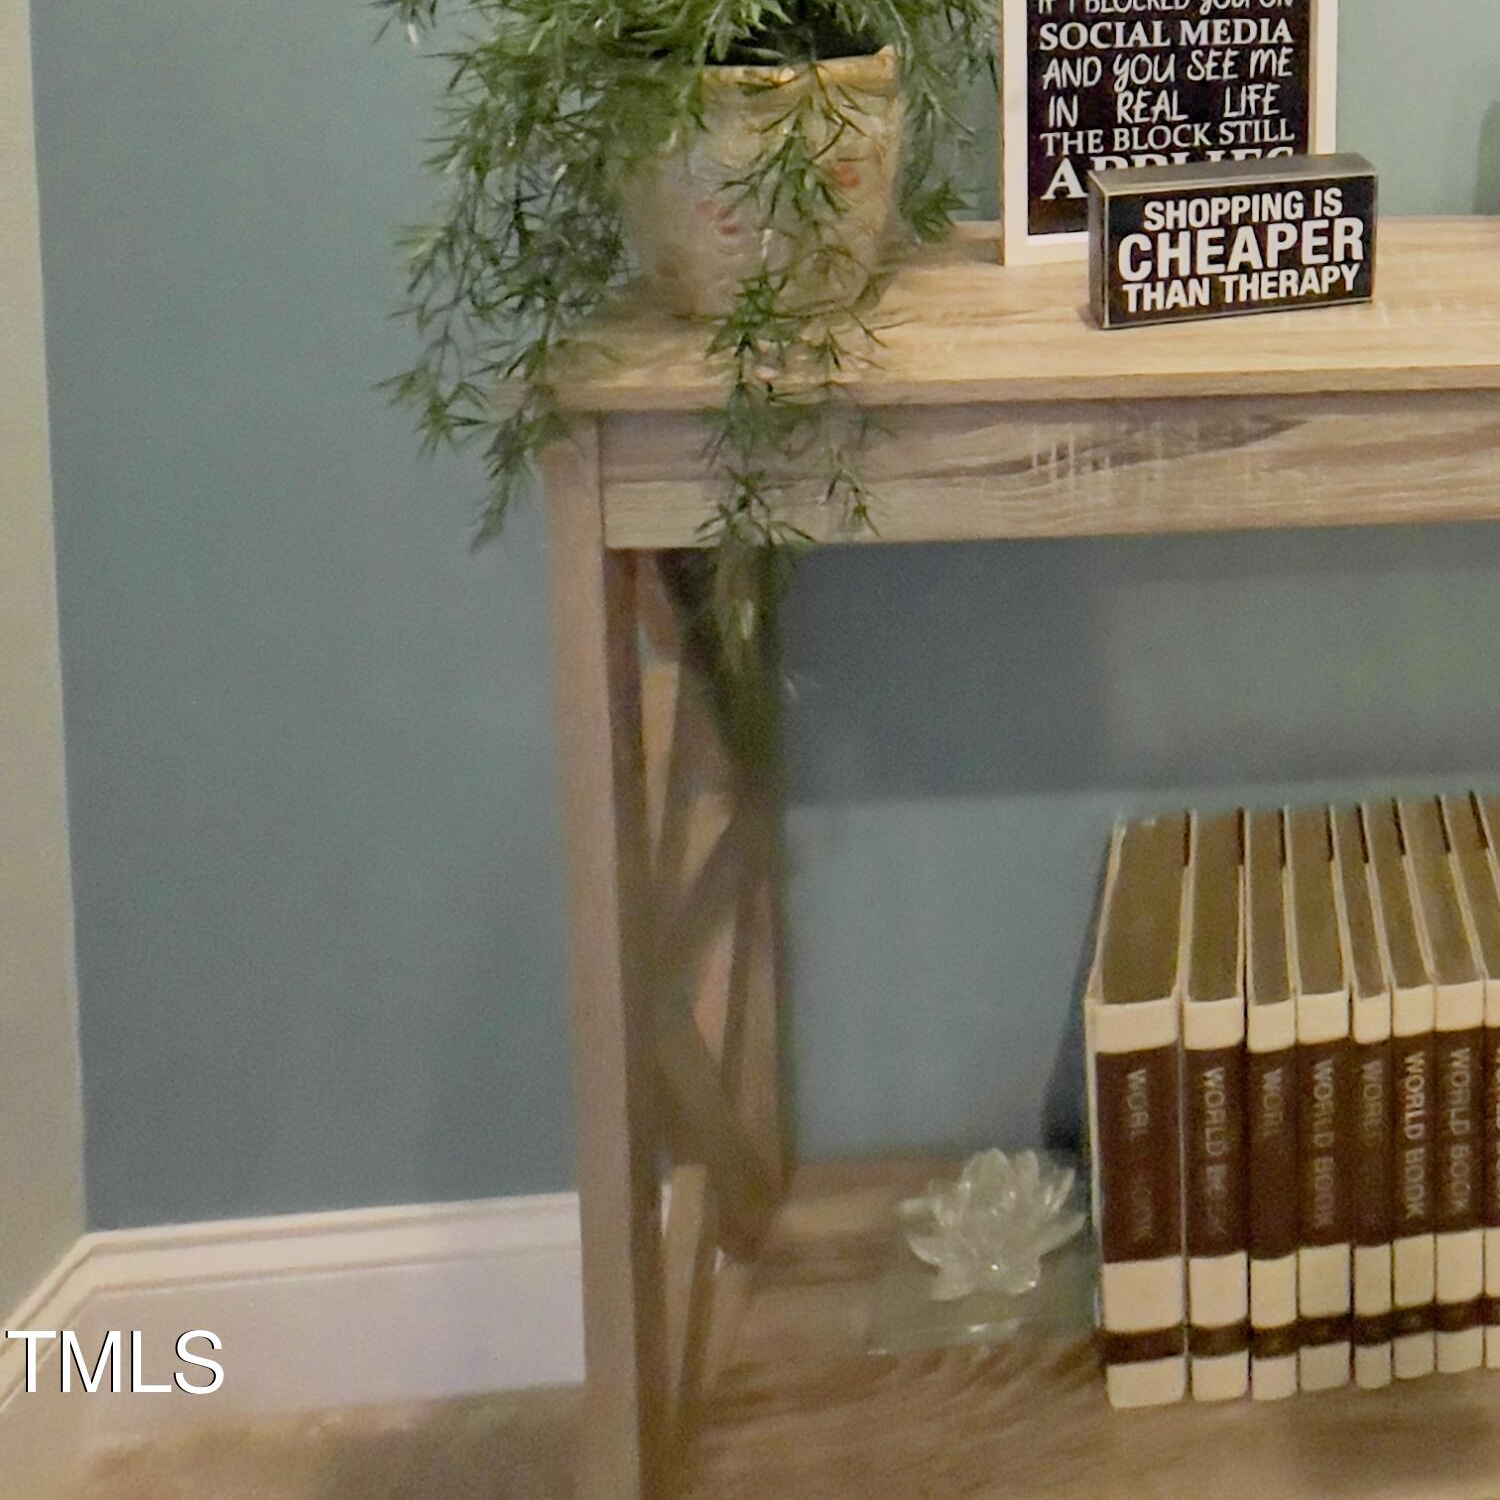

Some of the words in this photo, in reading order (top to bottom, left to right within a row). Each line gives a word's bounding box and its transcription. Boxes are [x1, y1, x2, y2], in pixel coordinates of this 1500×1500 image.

[1038, 20, 1172, 51] SOCIAL
[1179, 17, 1295, 47] MEDIA
[1042, 56, 1103, 91] AND
[1186, 48, 1240, 81] SEE
[1039, 129, 1104, 157] THE
[1113, 121, 1213, 152] BLOCK
[1218, 118, 1296, 146] STILL
[1048, 95, 1079, 128] IN
[1116, 89, 1190, 125] REAL
[1223, 82, 1281, 118] LIFE
[1143, 189, 1305, 232] SHOPPING
[1313, 187, 1344, 219] IS
[1117, 216, 1365, 282] CHEAPER
[1121, 277, 1211, 313] THAN
[1218, 263, 1361, 303] THERAPY
[1125, 1066, 1151, 1154] WORL
[1203, 1064, 1227, 1157] WORLD
[1311, 1056, 1336, 1148] WORLD
[1403, 1050, 1427, 1141] WORLD
[1449, 1047, 1473, 1136] WORLD
[1404, 1146, 1427, 1220] BOOK
